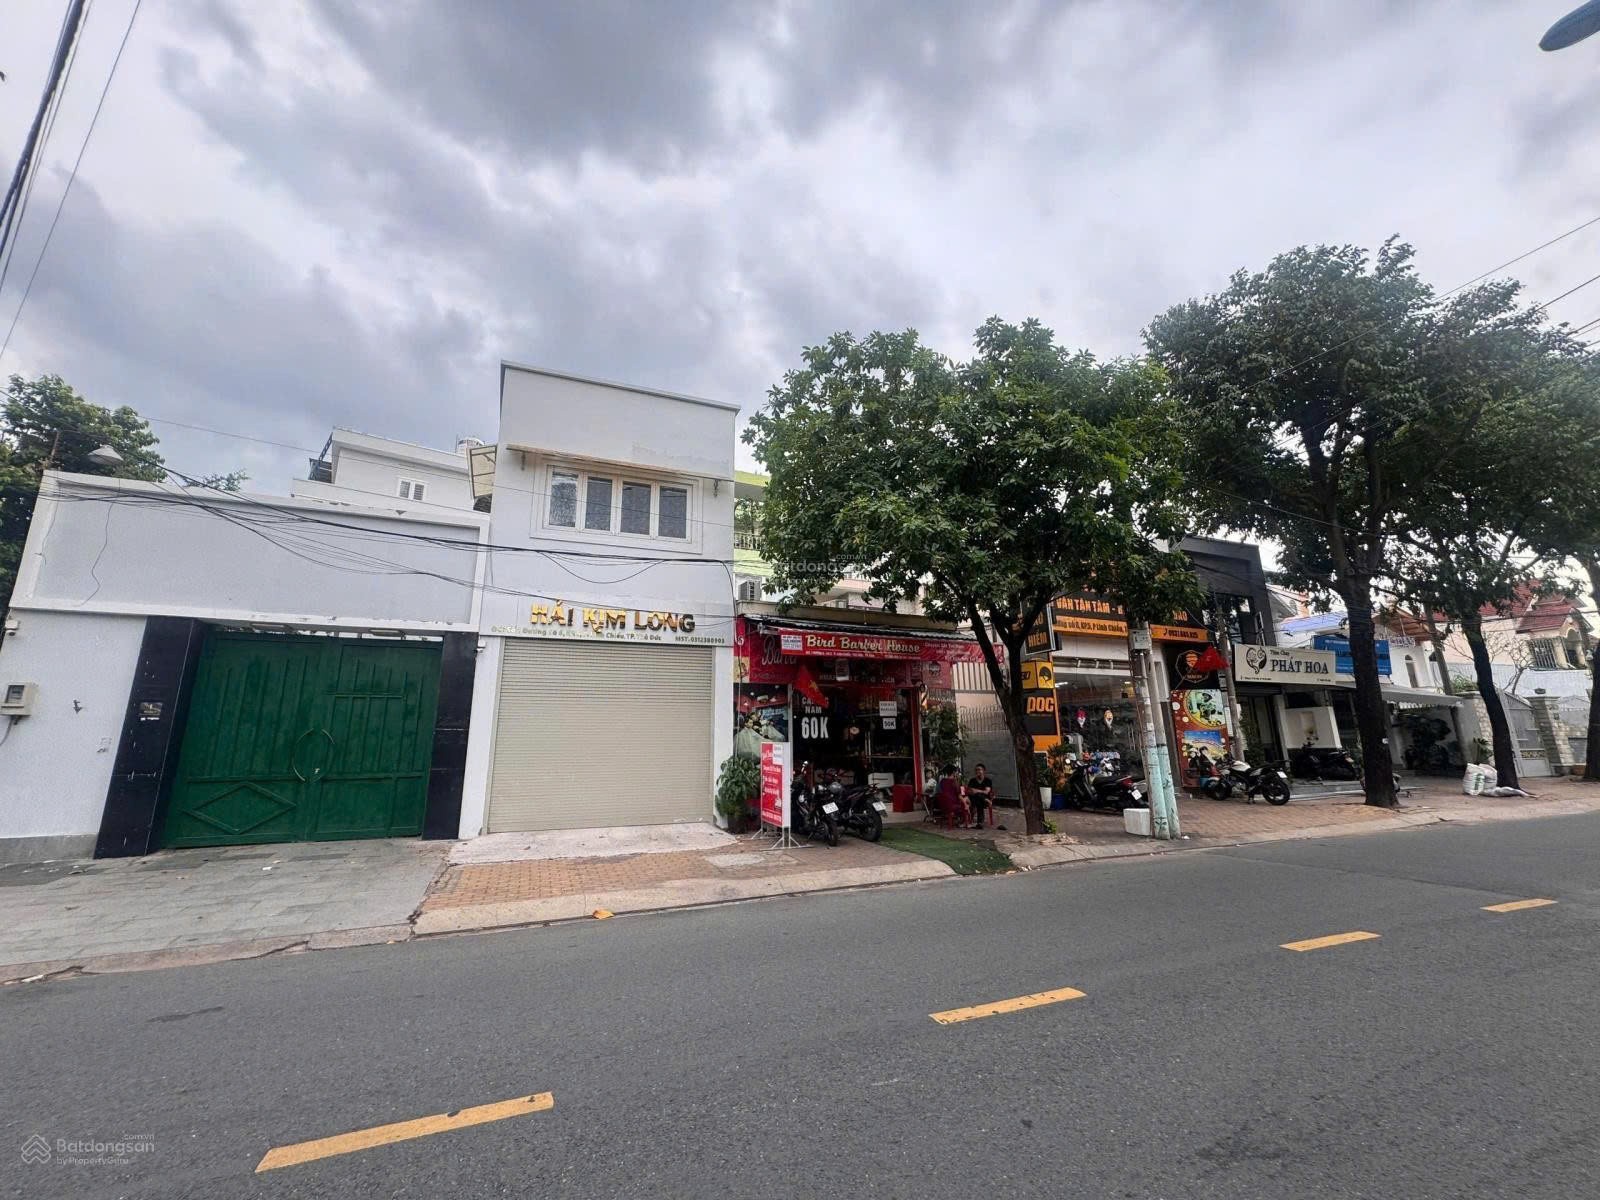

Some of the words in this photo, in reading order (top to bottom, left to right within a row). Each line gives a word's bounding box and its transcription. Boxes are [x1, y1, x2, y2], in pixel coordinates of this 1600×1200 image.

[582, 607, 626, 631] KIM
[634, 610, 696, 633] LONG
[806, 634, 837, 648] Bird
[840, 636, 883, 653] Barber
[887, 639, 921, 653] House
[1304, 660, 1329, 675] HOA
[801, 716, 829, 739] 60K
